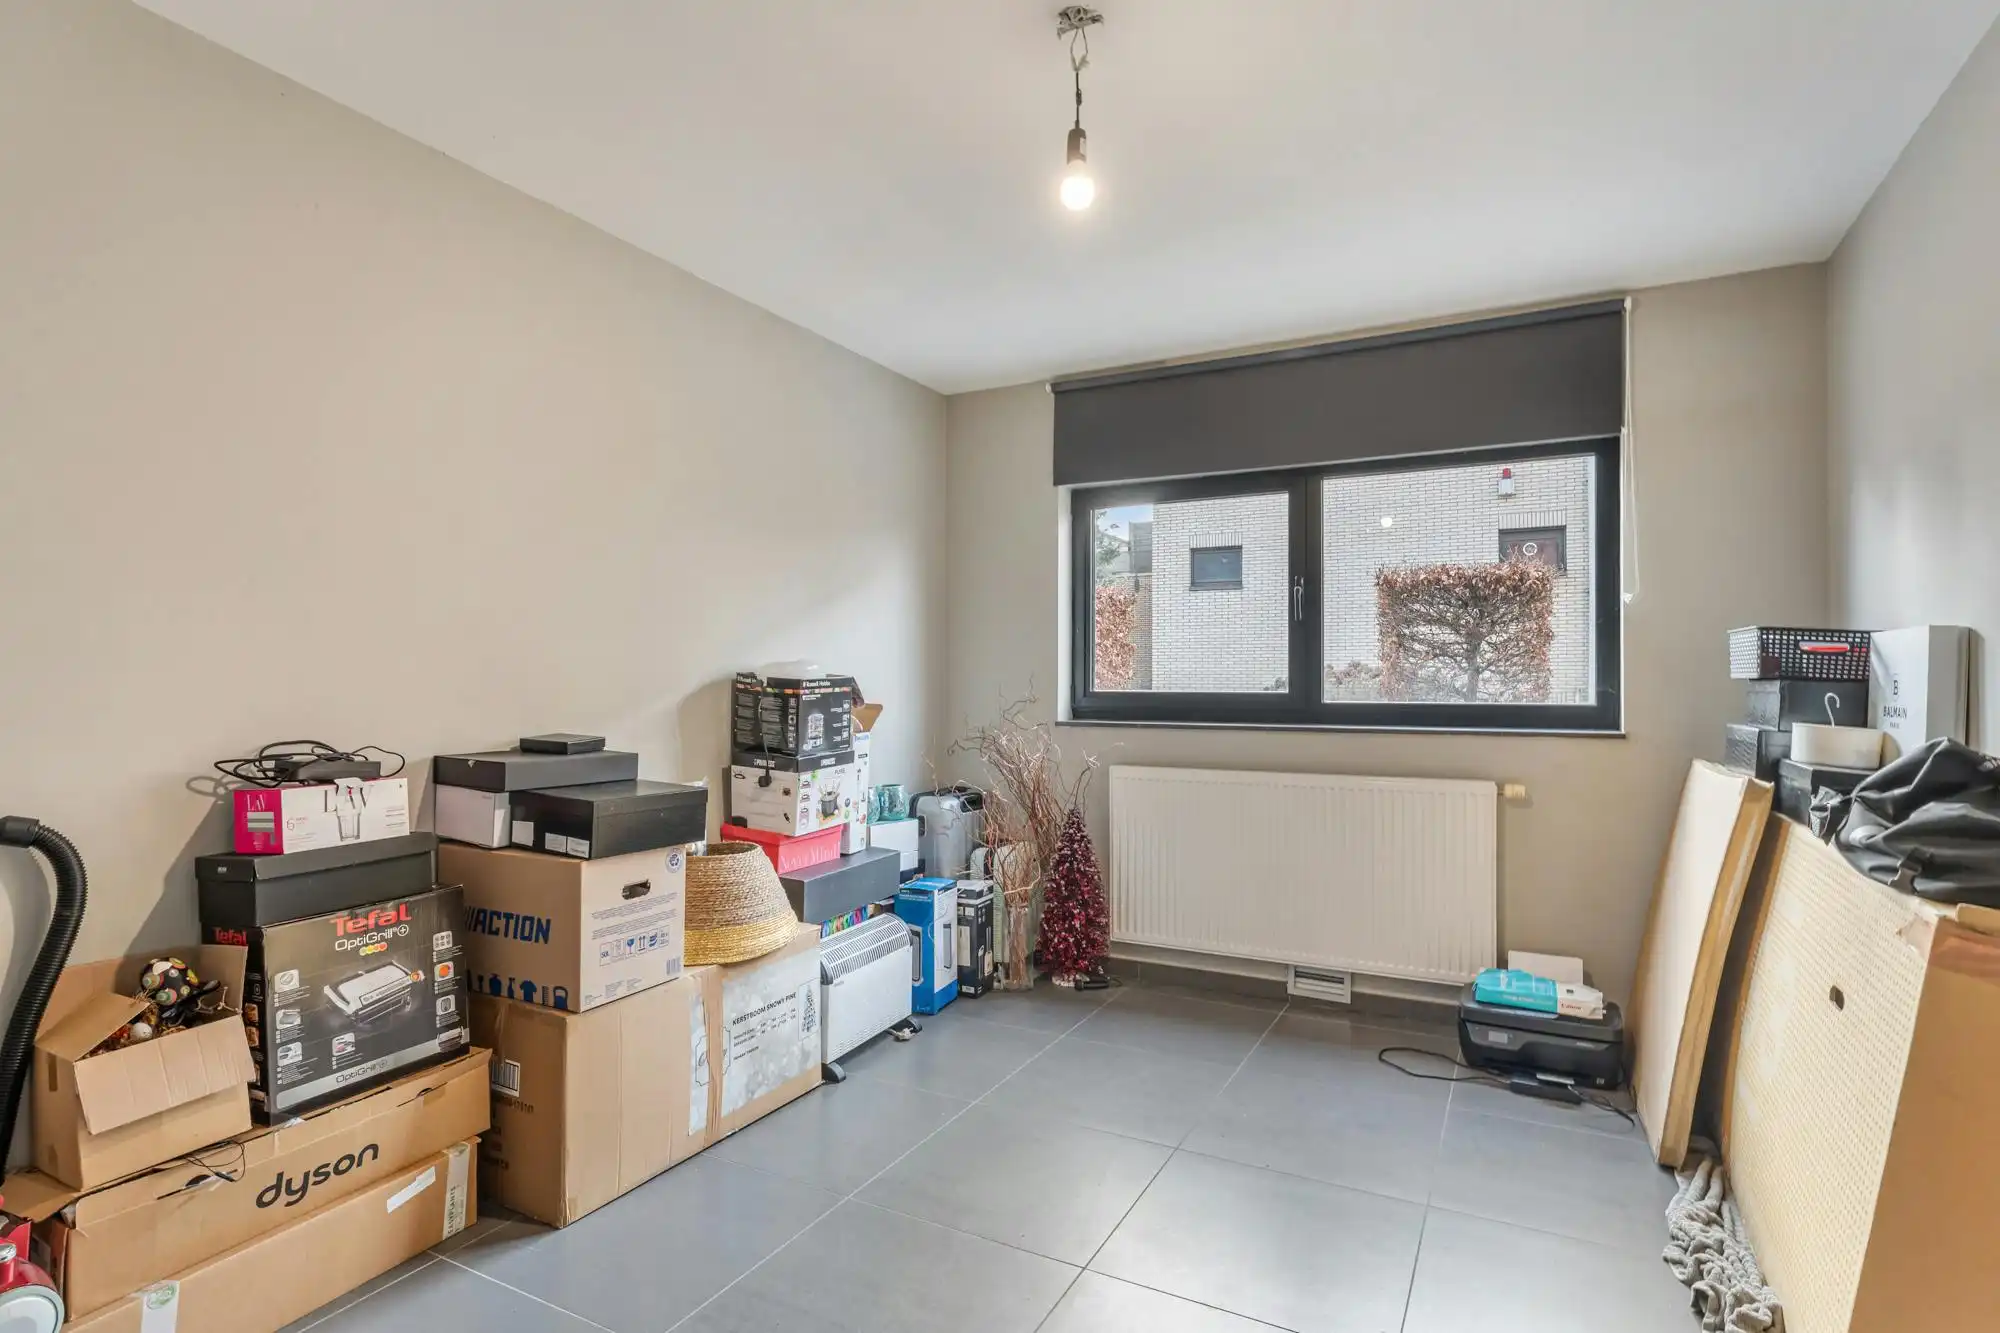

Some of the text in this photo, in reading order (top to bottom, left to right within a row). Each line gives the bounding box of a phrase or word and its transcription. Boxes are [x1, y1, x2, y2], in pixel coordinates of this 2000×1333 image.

[1893, 679, 1899, 696] B
[1883, 705, 1908, 719] BALMAIN
[214, 927, 248, 945] Tefal
[330, 902, 413, 937] Tefal
[473, 908, 552, 945] ACTION
[732, 991, 797, 1026] KERSTBOOM SNOWY PINE
[255, 1143, 380, 1209] dyson
